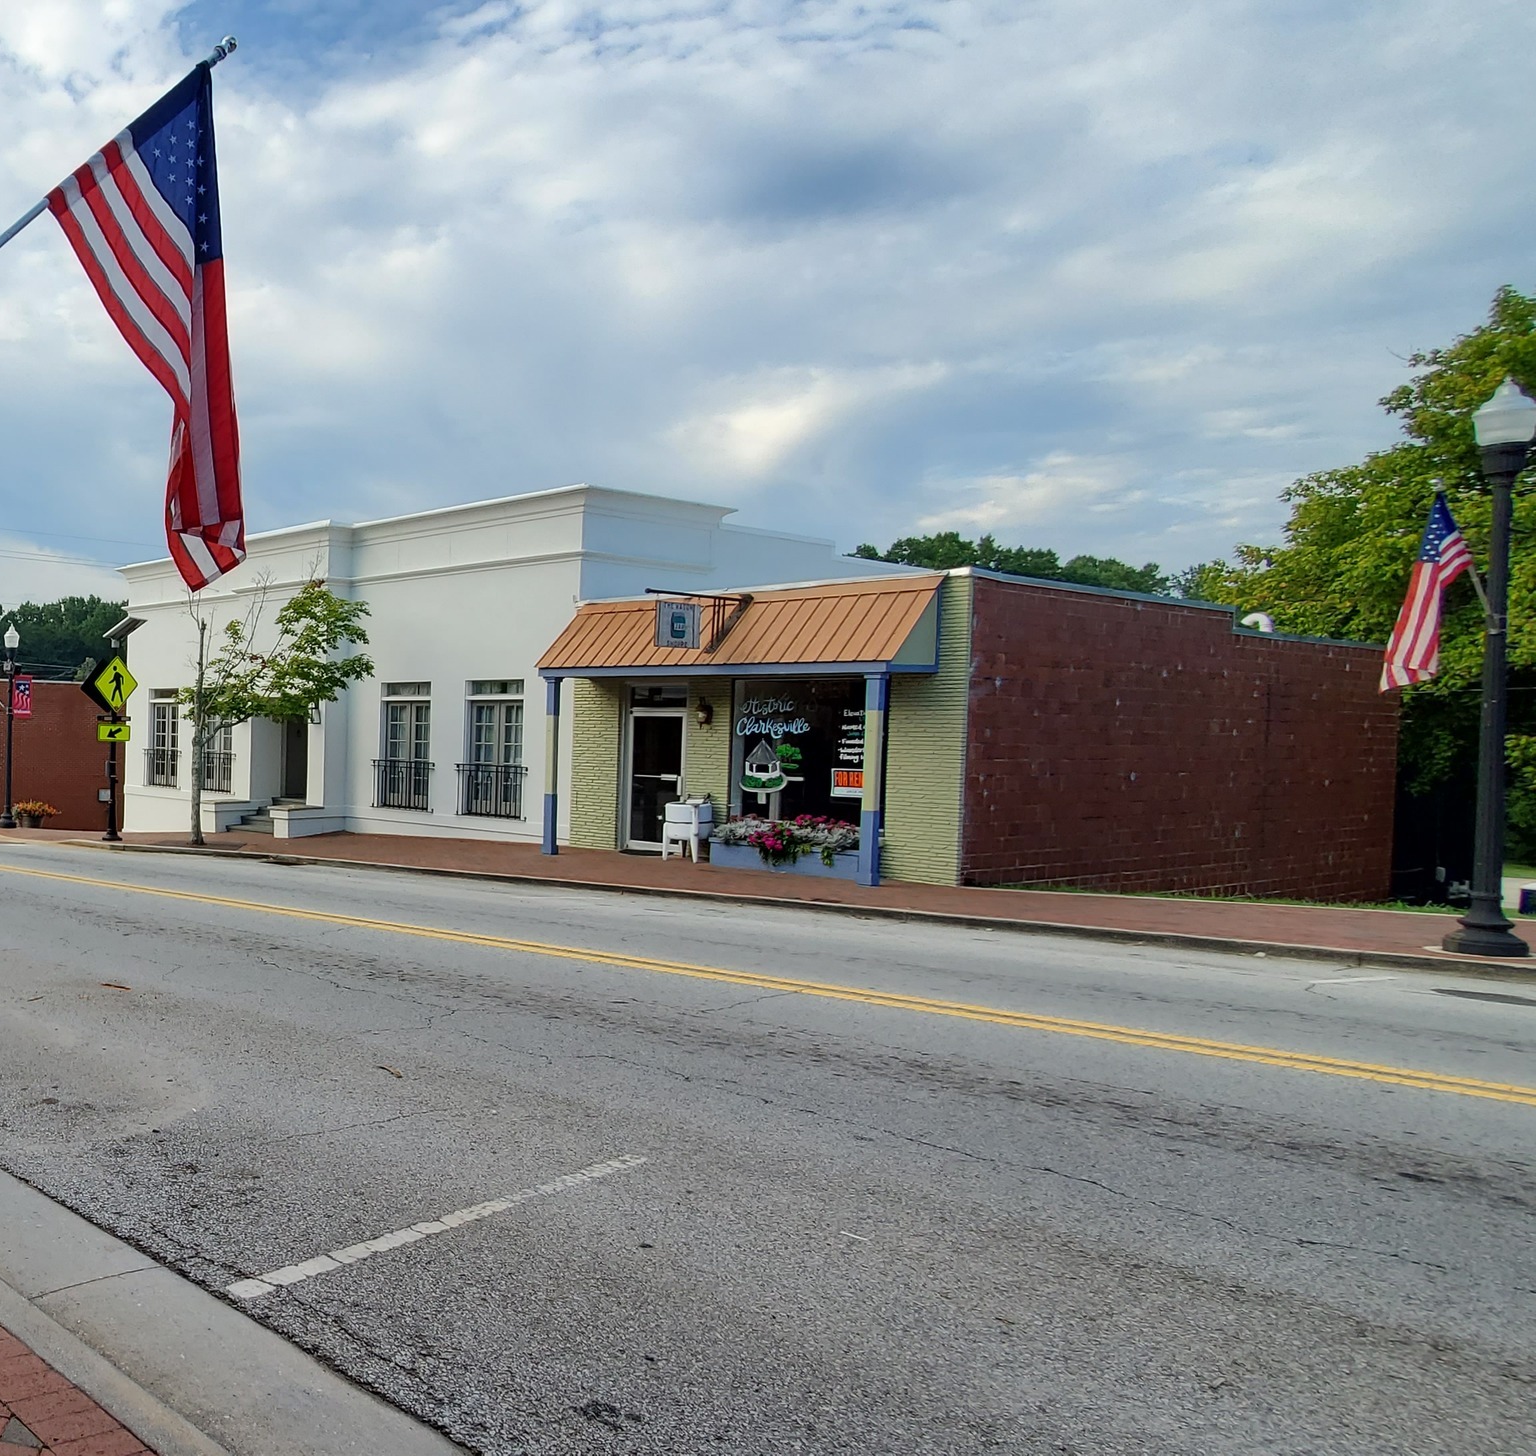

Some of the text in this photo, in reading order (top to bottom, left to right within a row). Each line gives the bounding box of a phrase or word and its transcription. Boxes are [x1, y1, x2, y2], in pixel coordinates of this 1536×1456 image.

[740, 692, 795, 715] Historic
[736, 716, 811, 739] Clarkesville
[834, 771, 848, 786] FOR
